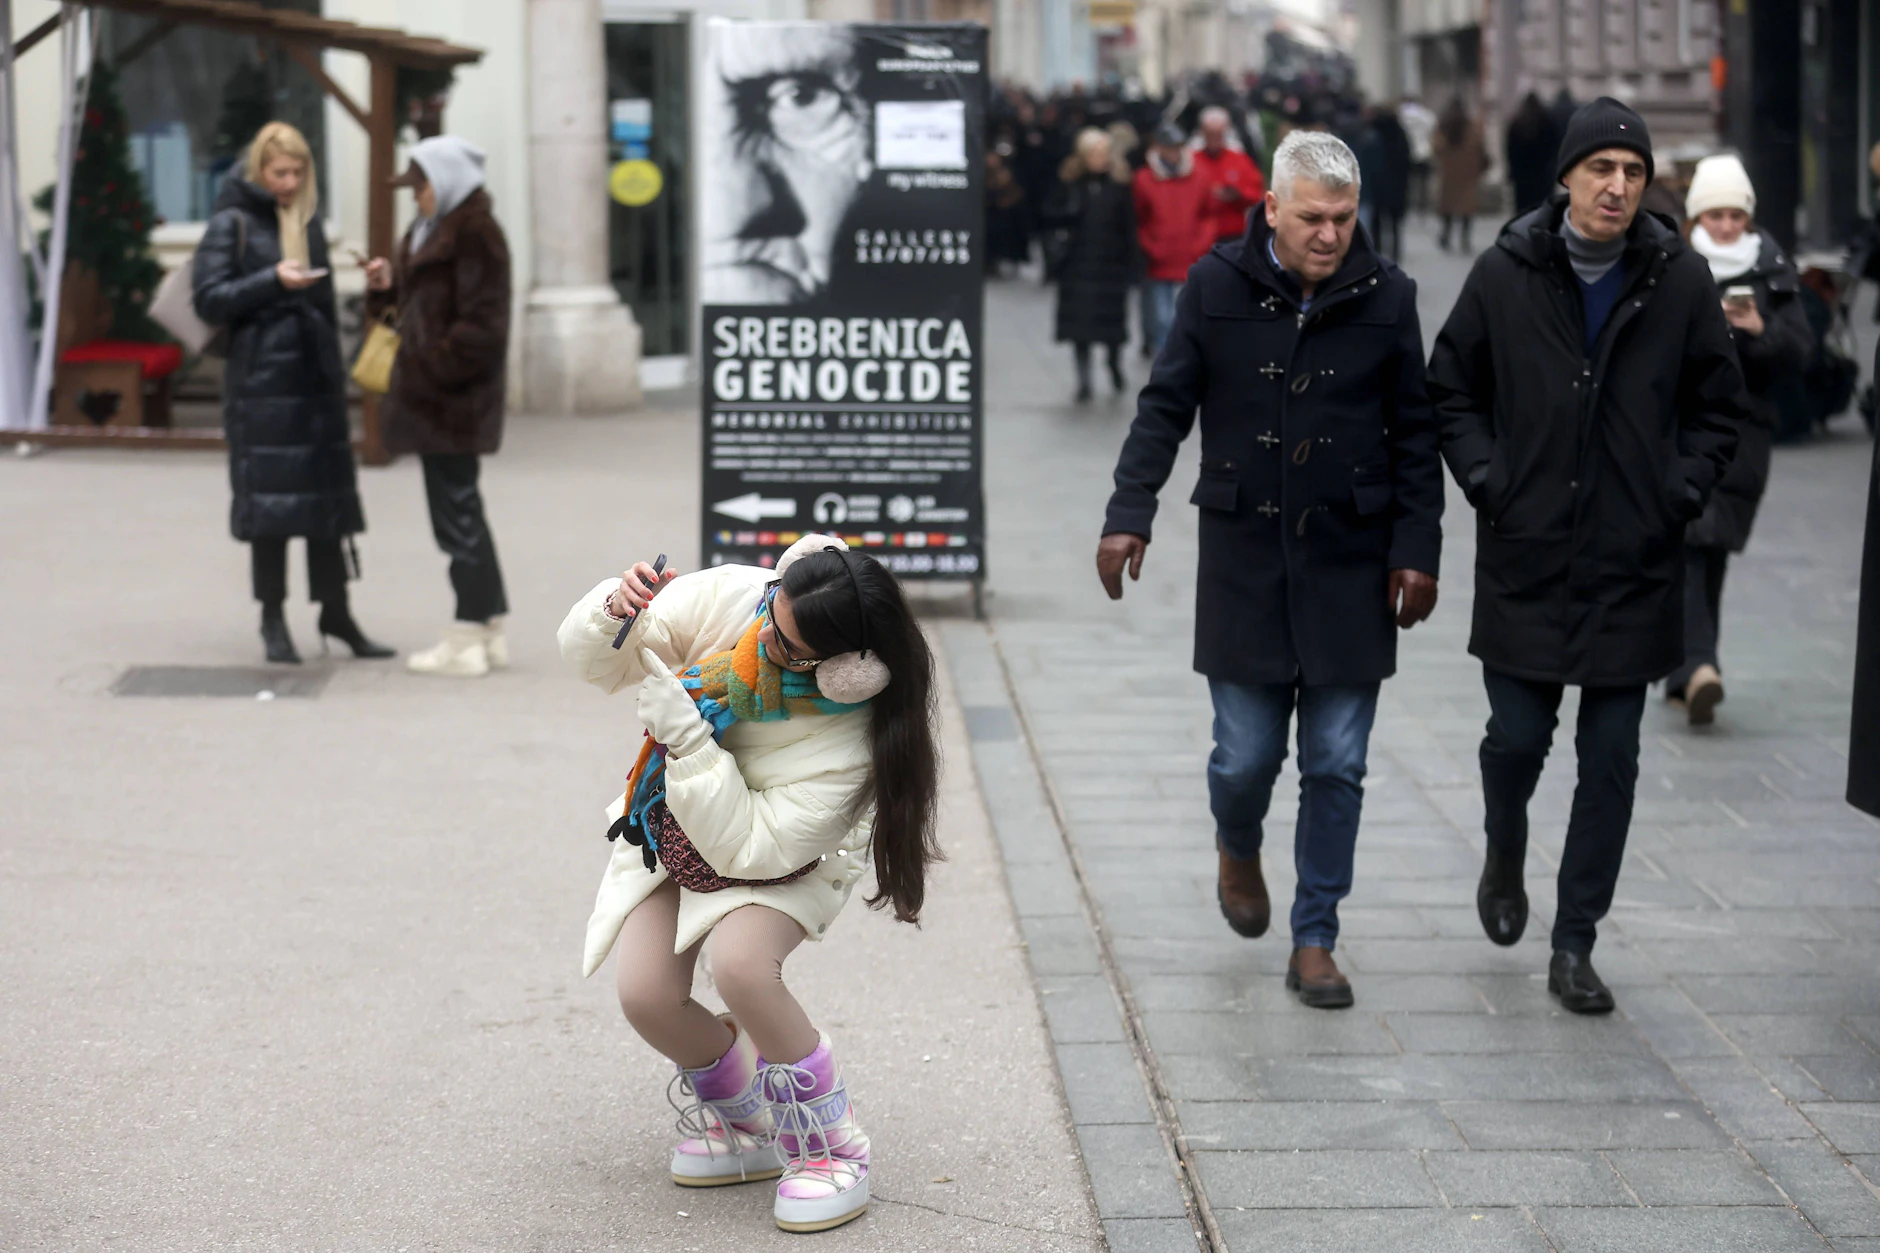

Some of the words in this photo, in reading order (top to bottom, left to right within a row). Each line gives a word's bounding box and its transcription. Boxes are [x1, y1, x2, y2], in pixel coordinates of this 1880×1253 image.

[855, 228, 971, 247] GALLERY
[712, 316, 972, 359] SREBRENICA
[712, 360, 972, 402] GENOCIDE
[711, 412, 827, 430] MEMORIAL
[838, 413, 972, 430] EXHIBITION
